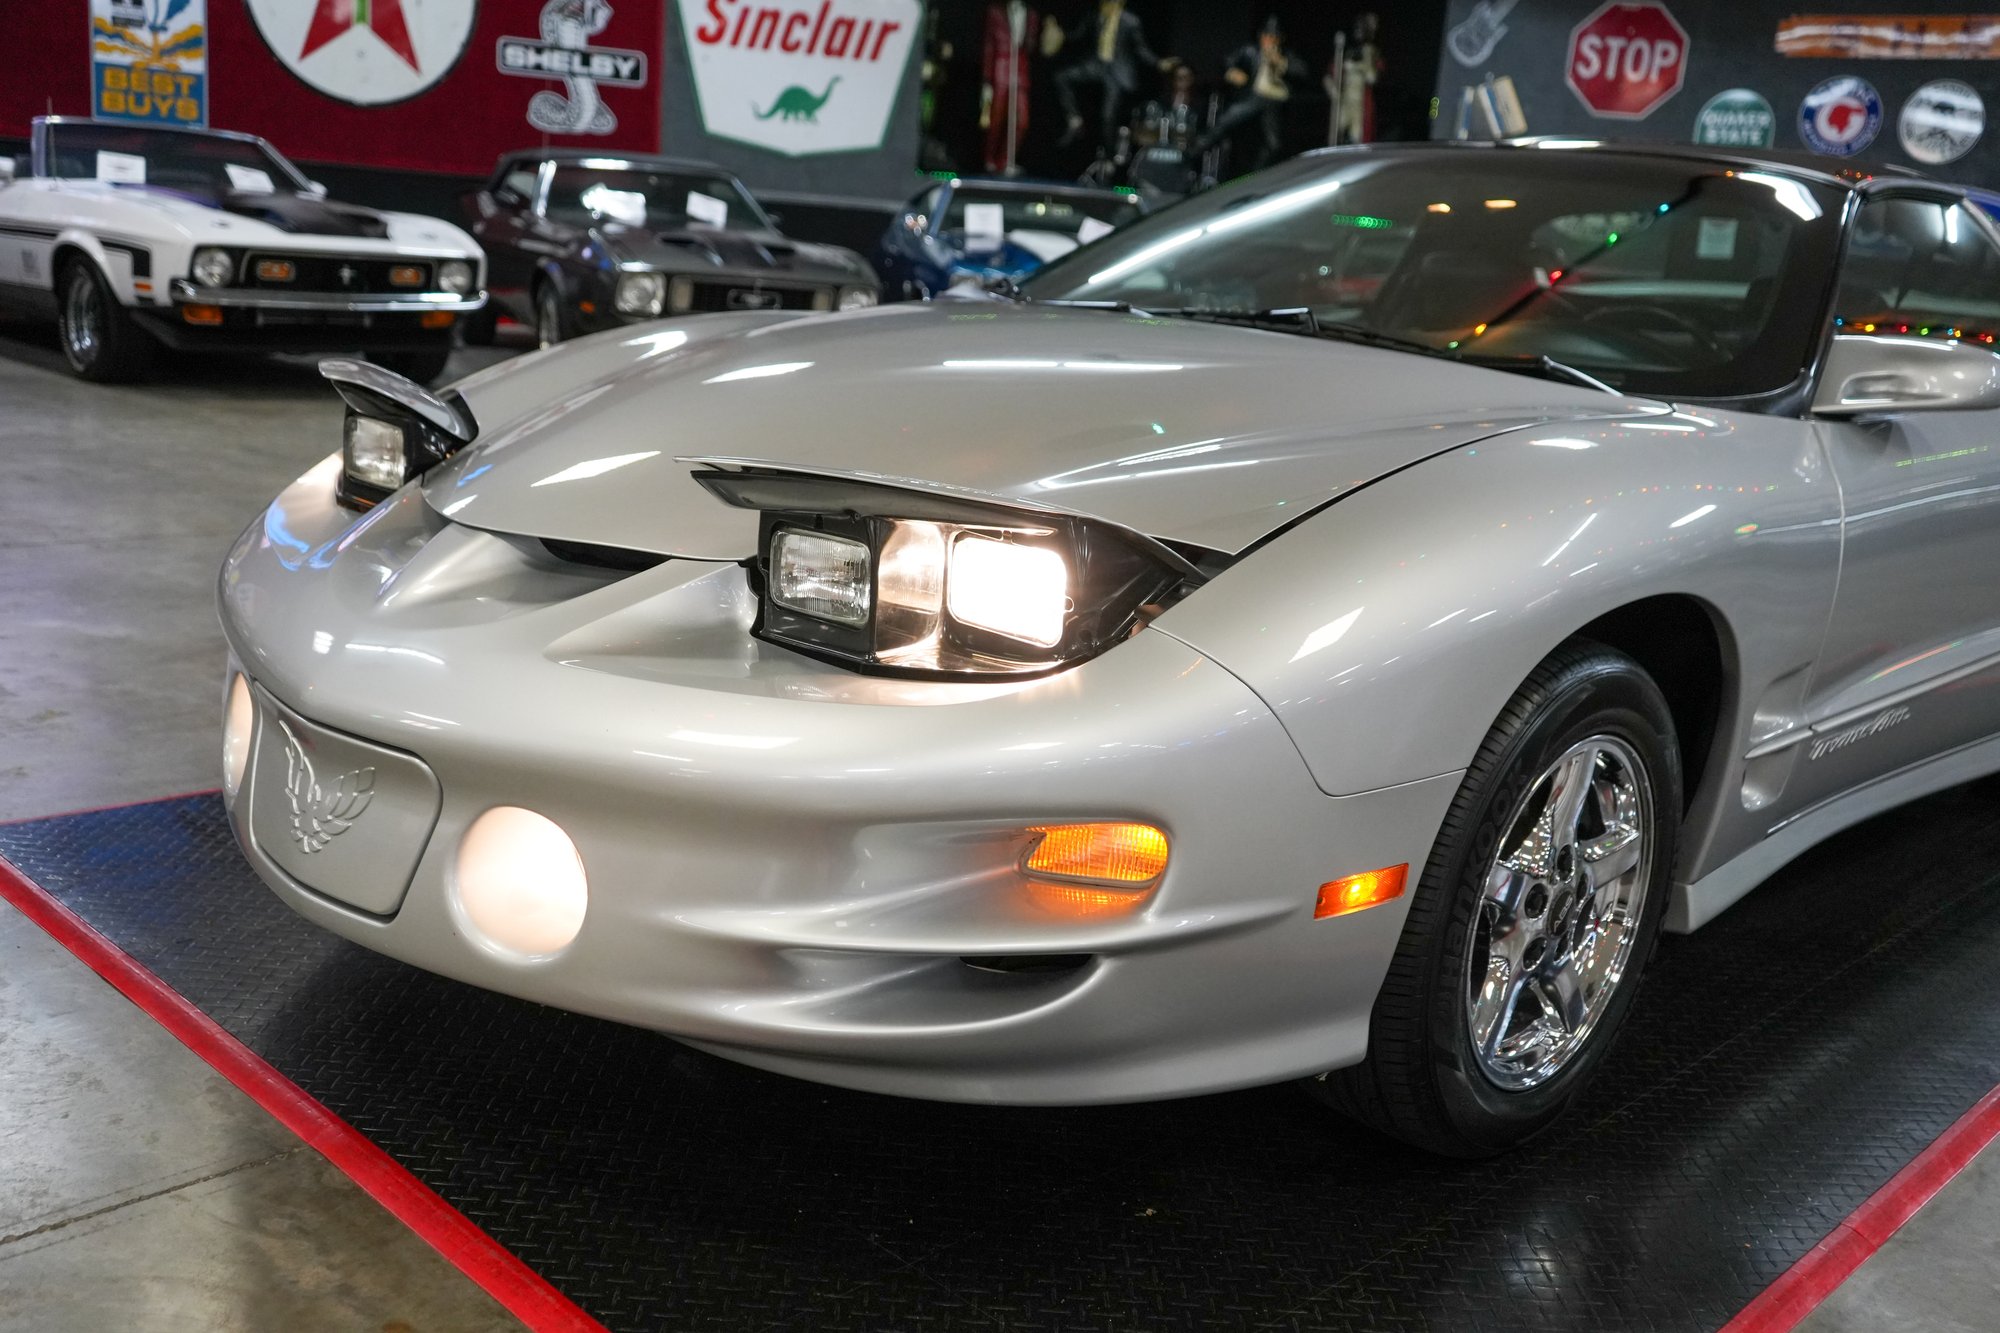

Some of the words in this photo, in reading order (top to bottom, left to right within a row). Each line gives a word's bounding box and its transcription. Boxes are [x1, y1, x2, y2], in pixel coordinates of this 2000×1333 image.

[696, 0, 900, 62] Sinclair
[503, 44, 638, 79] SHELBY
[1574, 34, 1679, 82] STOP
[103, 66, 196, 98] BEST
[102, 89, 199, 120] BUYS
